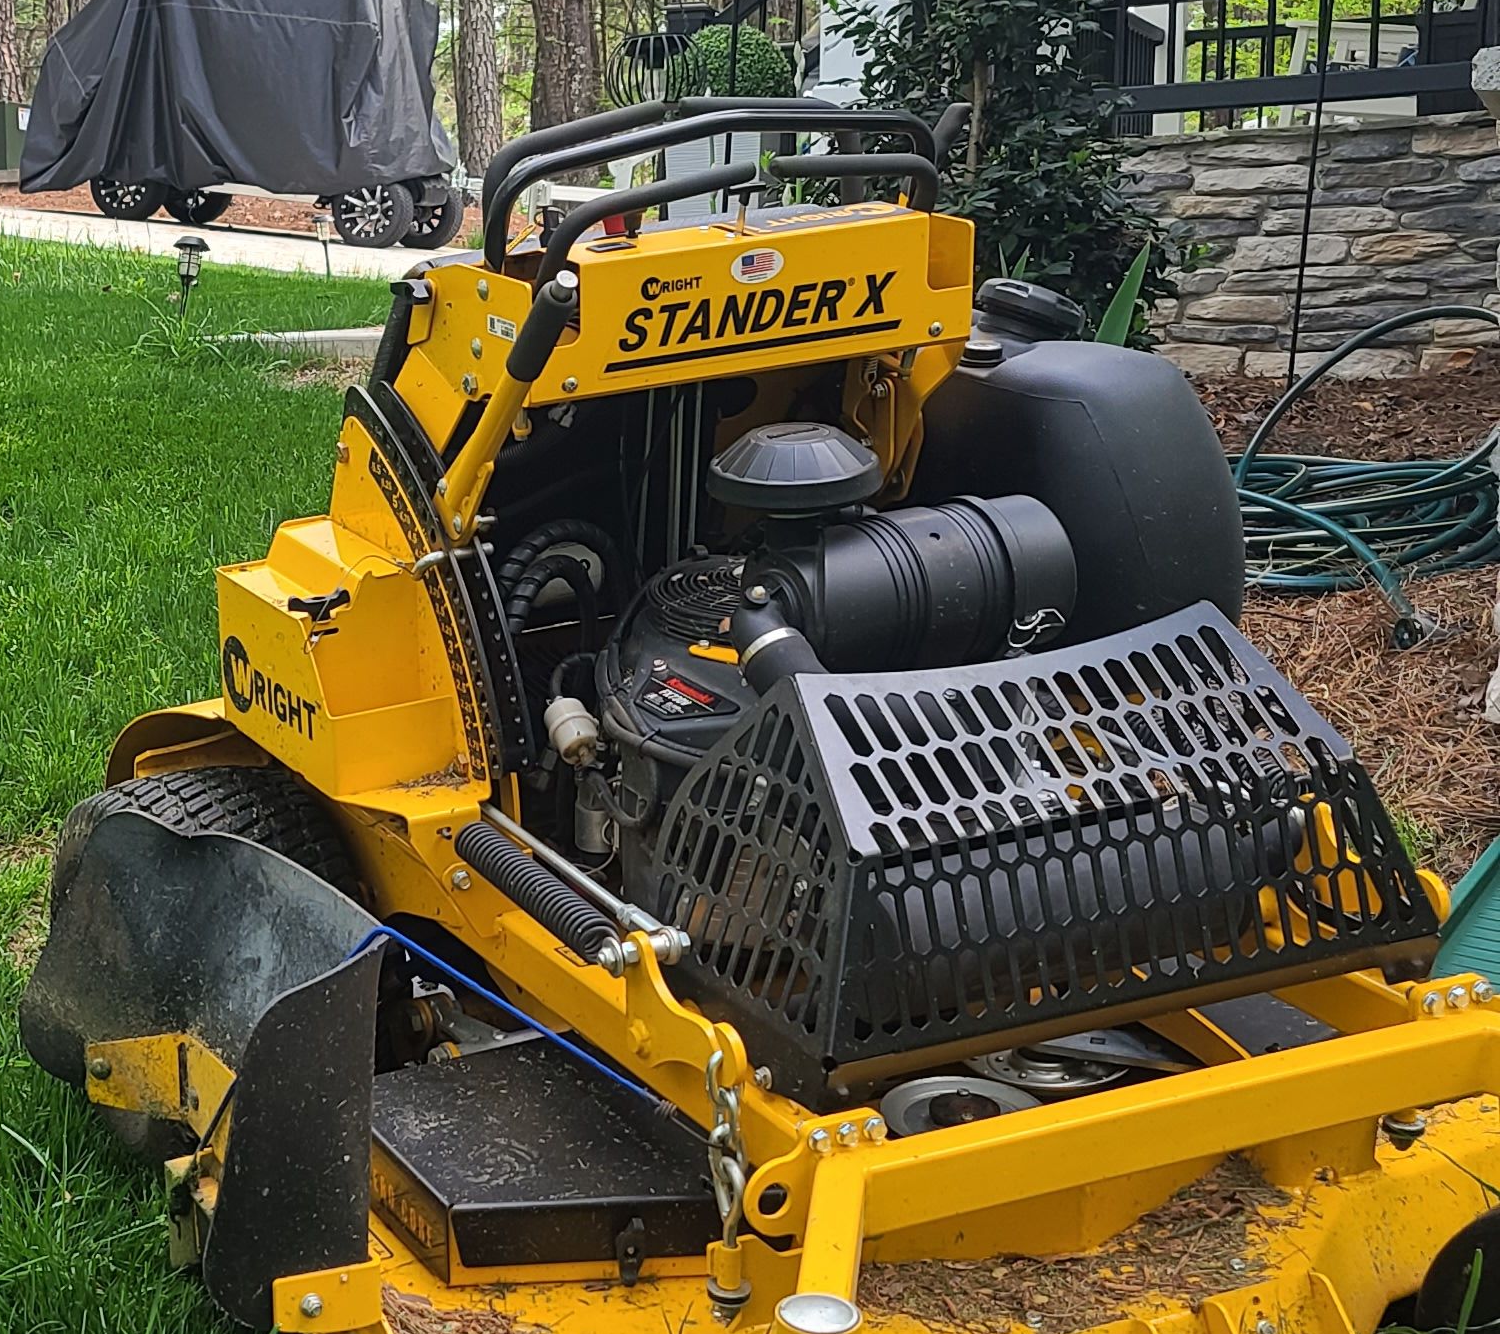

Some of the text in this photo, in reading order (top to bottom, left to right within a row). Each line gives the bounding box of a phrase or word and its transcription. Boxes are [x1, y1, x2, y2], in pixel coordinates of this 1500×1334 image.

[641, 276, 703, 301] WRIGHT
[853, 270, 897, 318] X
[392, 493, 399, 509] 5
[447, 639, 454, 654] 3
[223, 635, 316, 741] WRIGHT
[465, 715, 471, 730] 2
